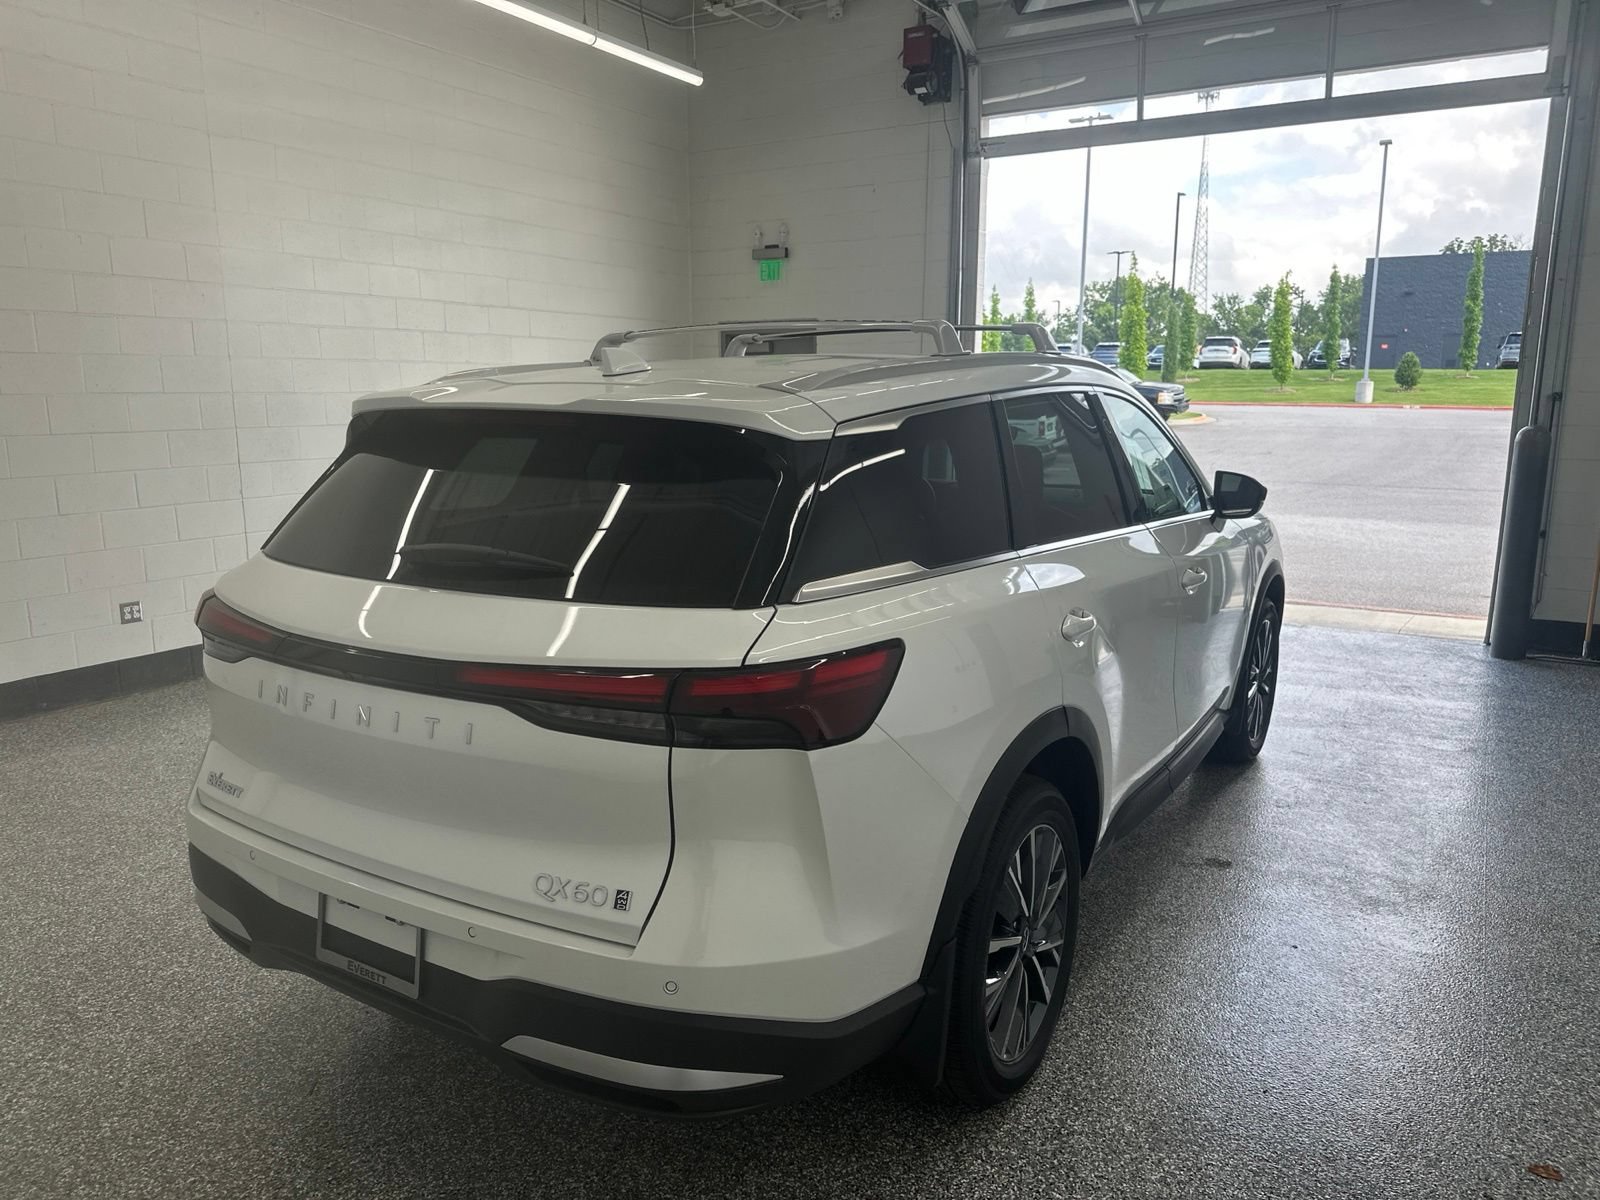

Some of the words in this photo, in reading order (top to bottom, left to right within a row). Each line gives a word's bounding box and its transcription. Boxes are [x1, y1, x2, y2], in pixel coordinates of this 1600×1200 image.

[760, 262, 781, 281] EXIT
[257, 680, 473, 745] INFINITI
[535, 873, 608, 907] QX60
[616, 891, 628, 910] AWD
[347, 960, 386, 984] EVERETT
